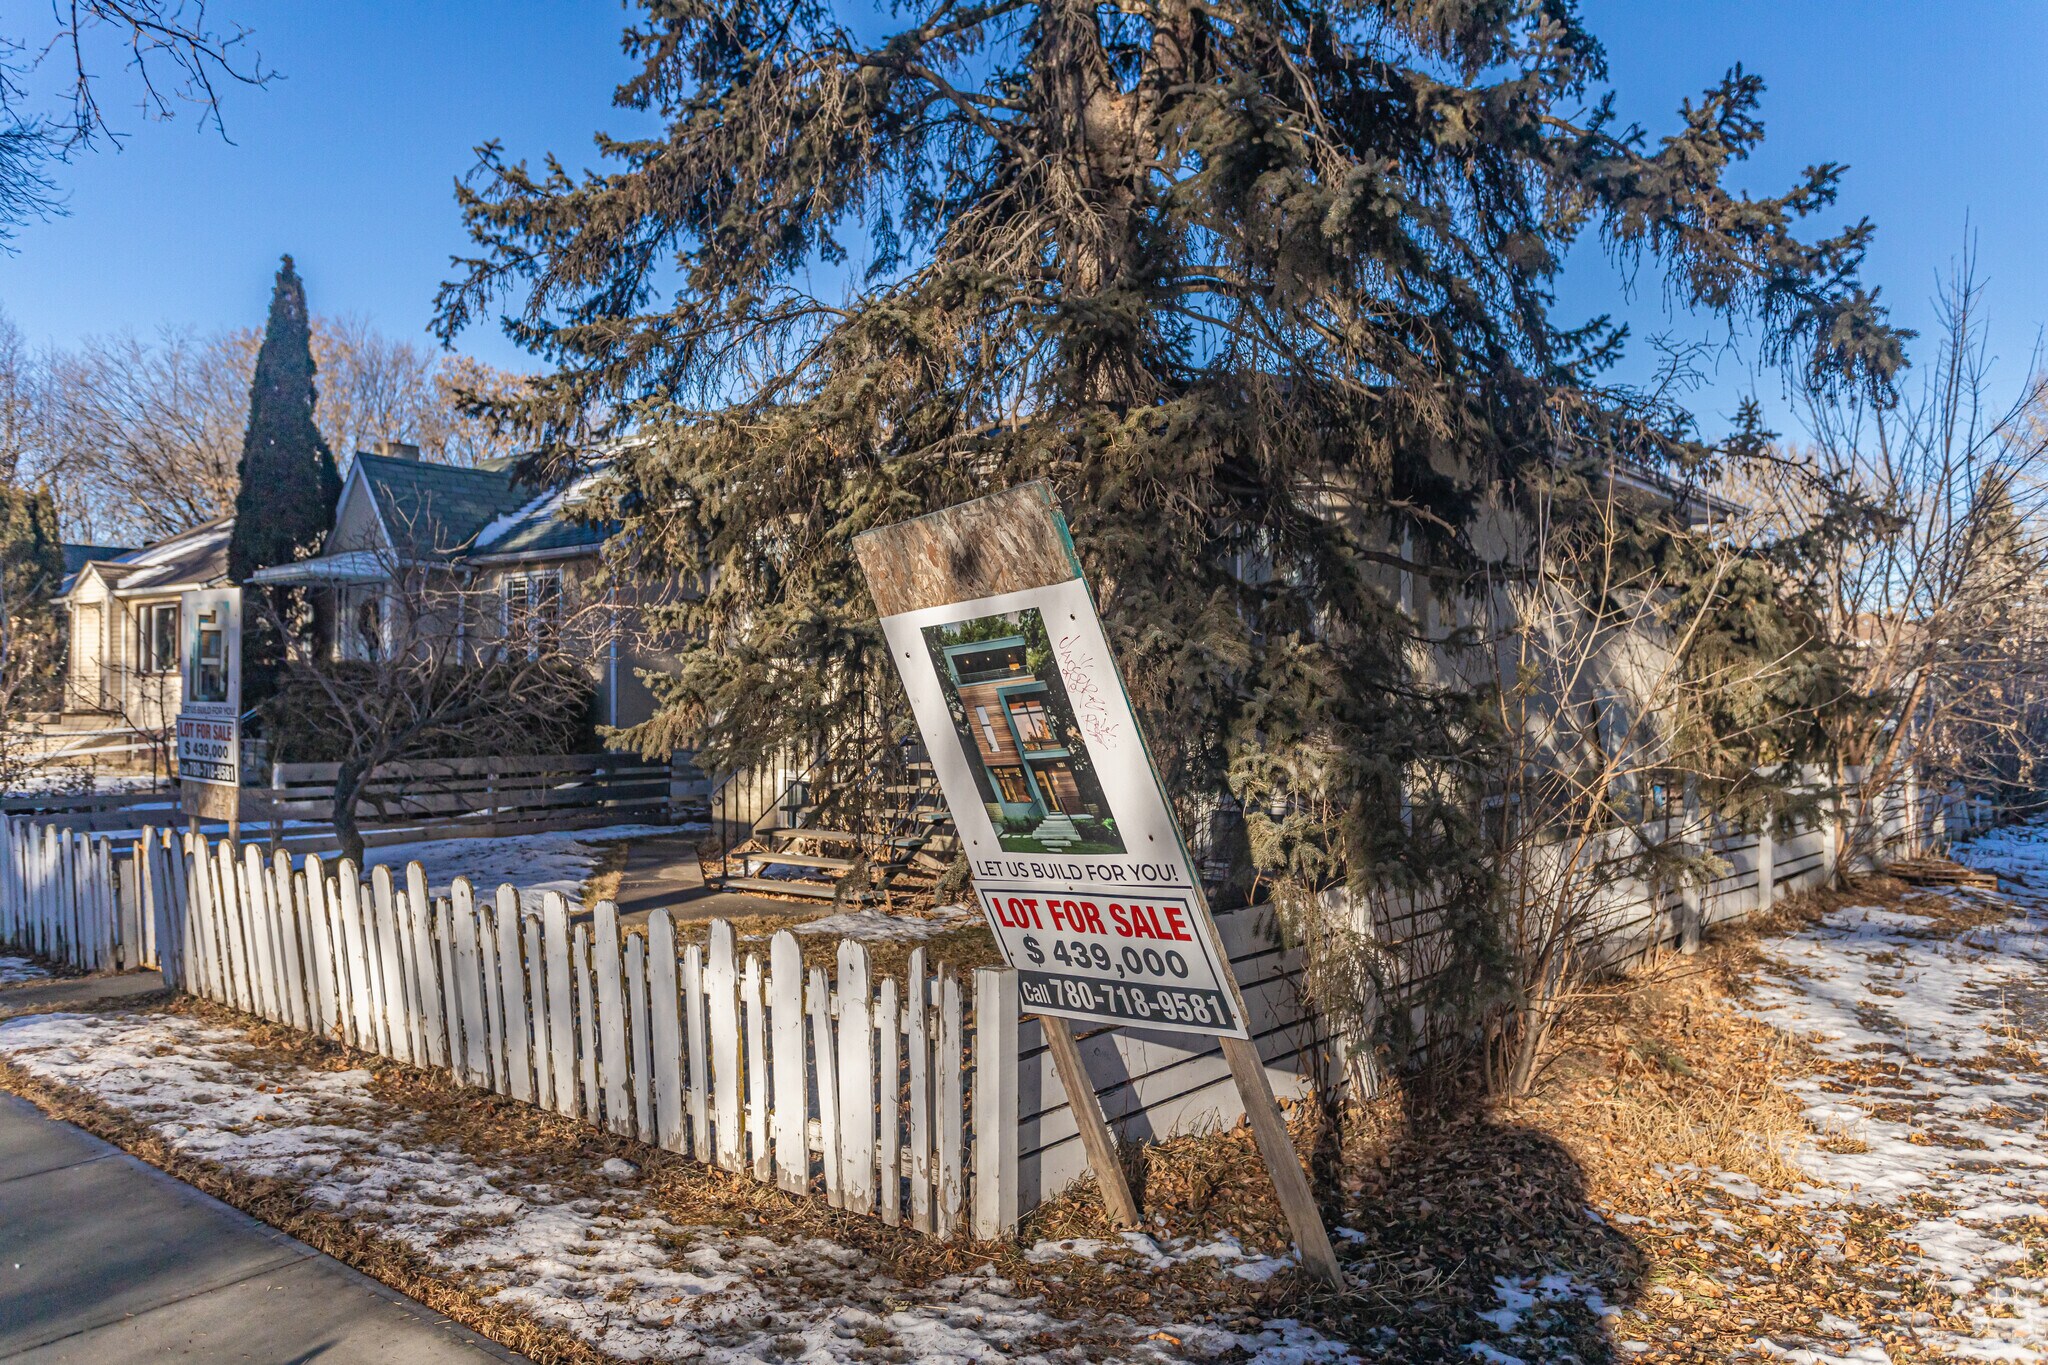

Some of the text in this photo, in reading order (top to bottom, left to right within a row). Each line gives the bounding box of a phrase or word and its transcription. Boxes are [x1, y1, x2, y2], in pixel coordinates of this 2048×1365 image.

[180, 722, 232, 742] LOT FOR SALE
[184, 741, 228, 760] $ 439,000
[976, 860, 1179, 882] LET US BUILD FOR YOU!
[992, 897, 1192, 942] LOT FOR SALE
[1023, 933, 1189, 979] $ 439,000
[1022, 979, 1226, 1026] Call 780-718-9581
